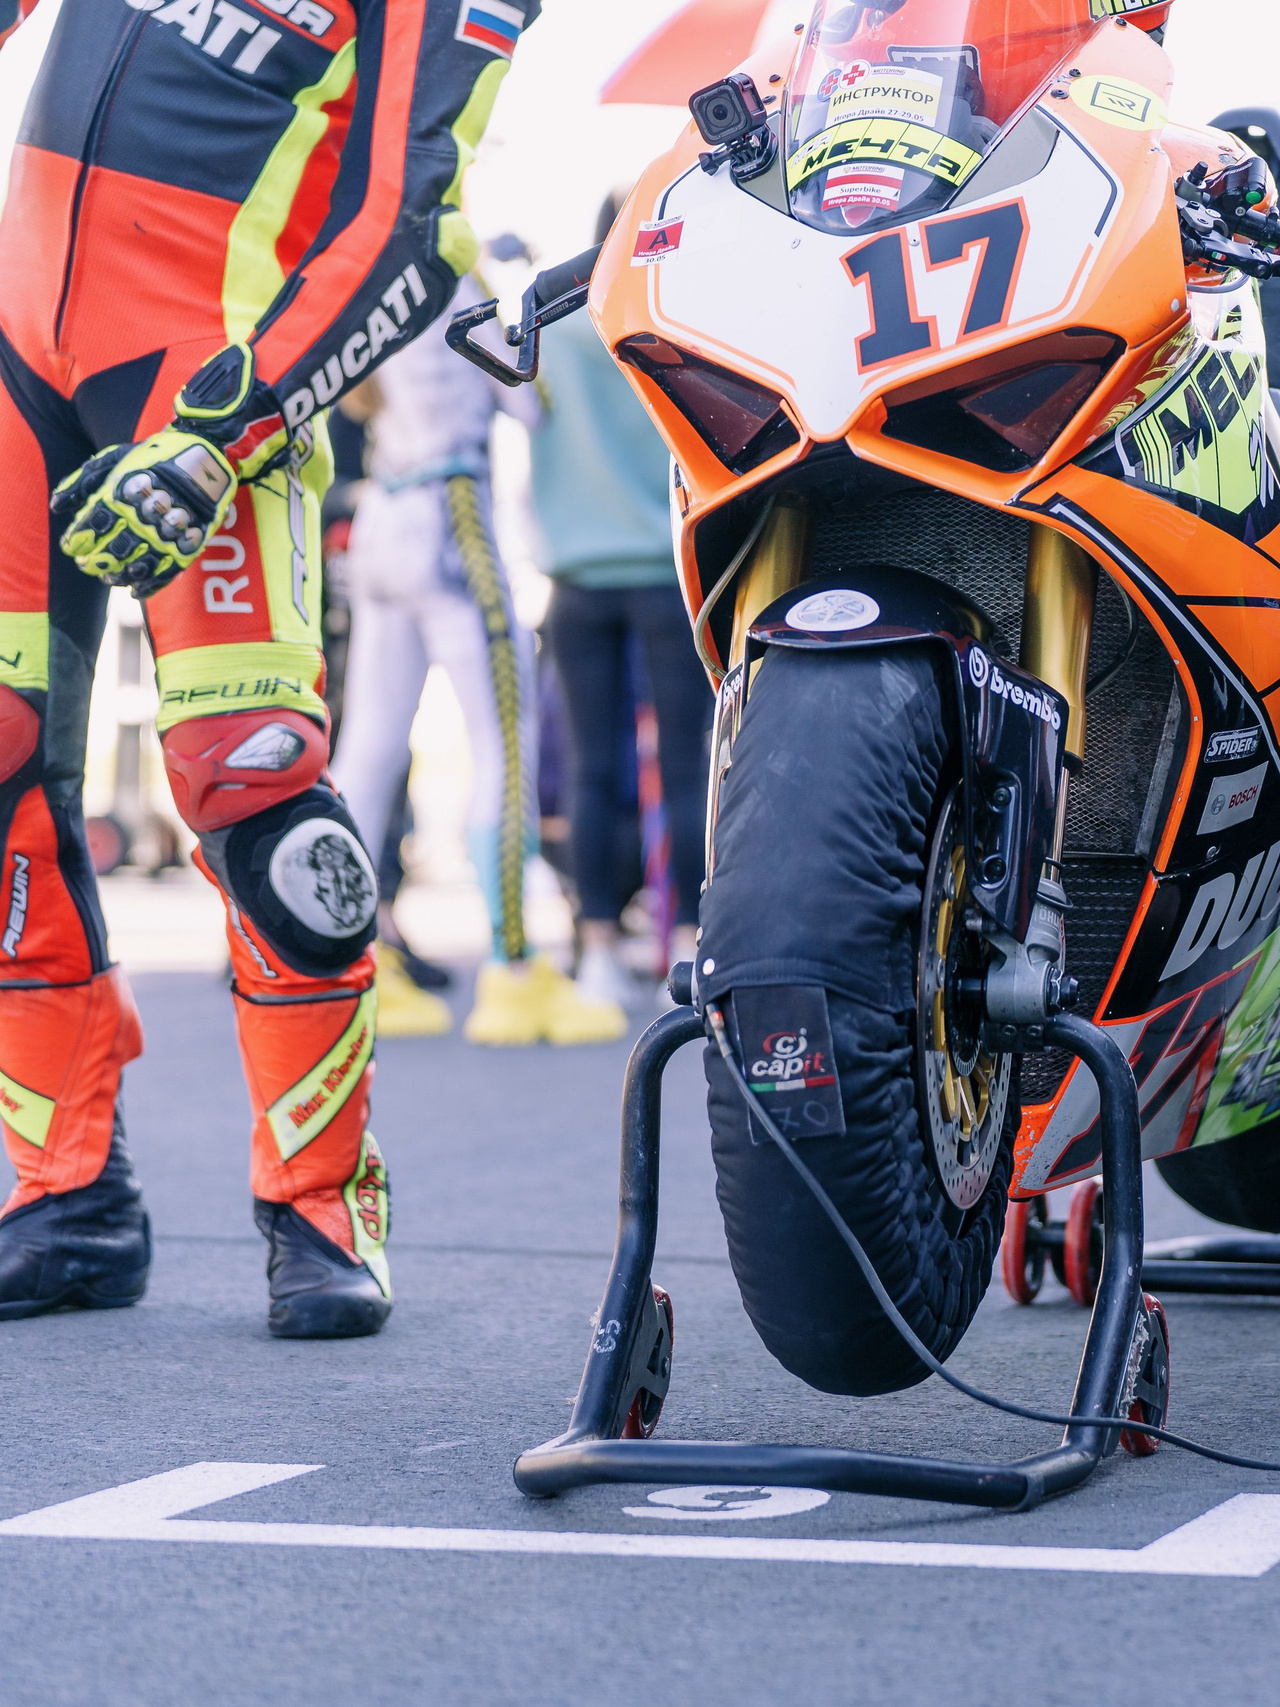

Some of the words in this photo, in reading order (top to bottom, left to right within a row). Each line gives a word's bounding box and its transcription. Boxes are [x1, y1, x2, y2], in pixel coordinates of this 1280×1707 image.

[125, 0, 282, 75] ATI
[833, 86, 934, 107] ИНСТРУКТОР
[834, 111, 856, 122] Игора
[858, 109, 885, 117] Драйв
[888, 109, 924, 122] 27-29.05
[827, 196, 847, 206] Игора
[848, 195, 871, 203] Драйв
[872, 196, 891, 206] 30.05
[840, 186, 881, 194] Superbike
[842, 199, 1028, 373] 17
[282, 263, 428, 430] DUCATI
[990, 666, 1061, 731] brembo
[1207, 730, 1258, 757] SPIDER
[1228, 784, 1259, 809] BOSCH
[751, 1051, 825, 1080] capit
[288, 1092, 329, 1128] Max
